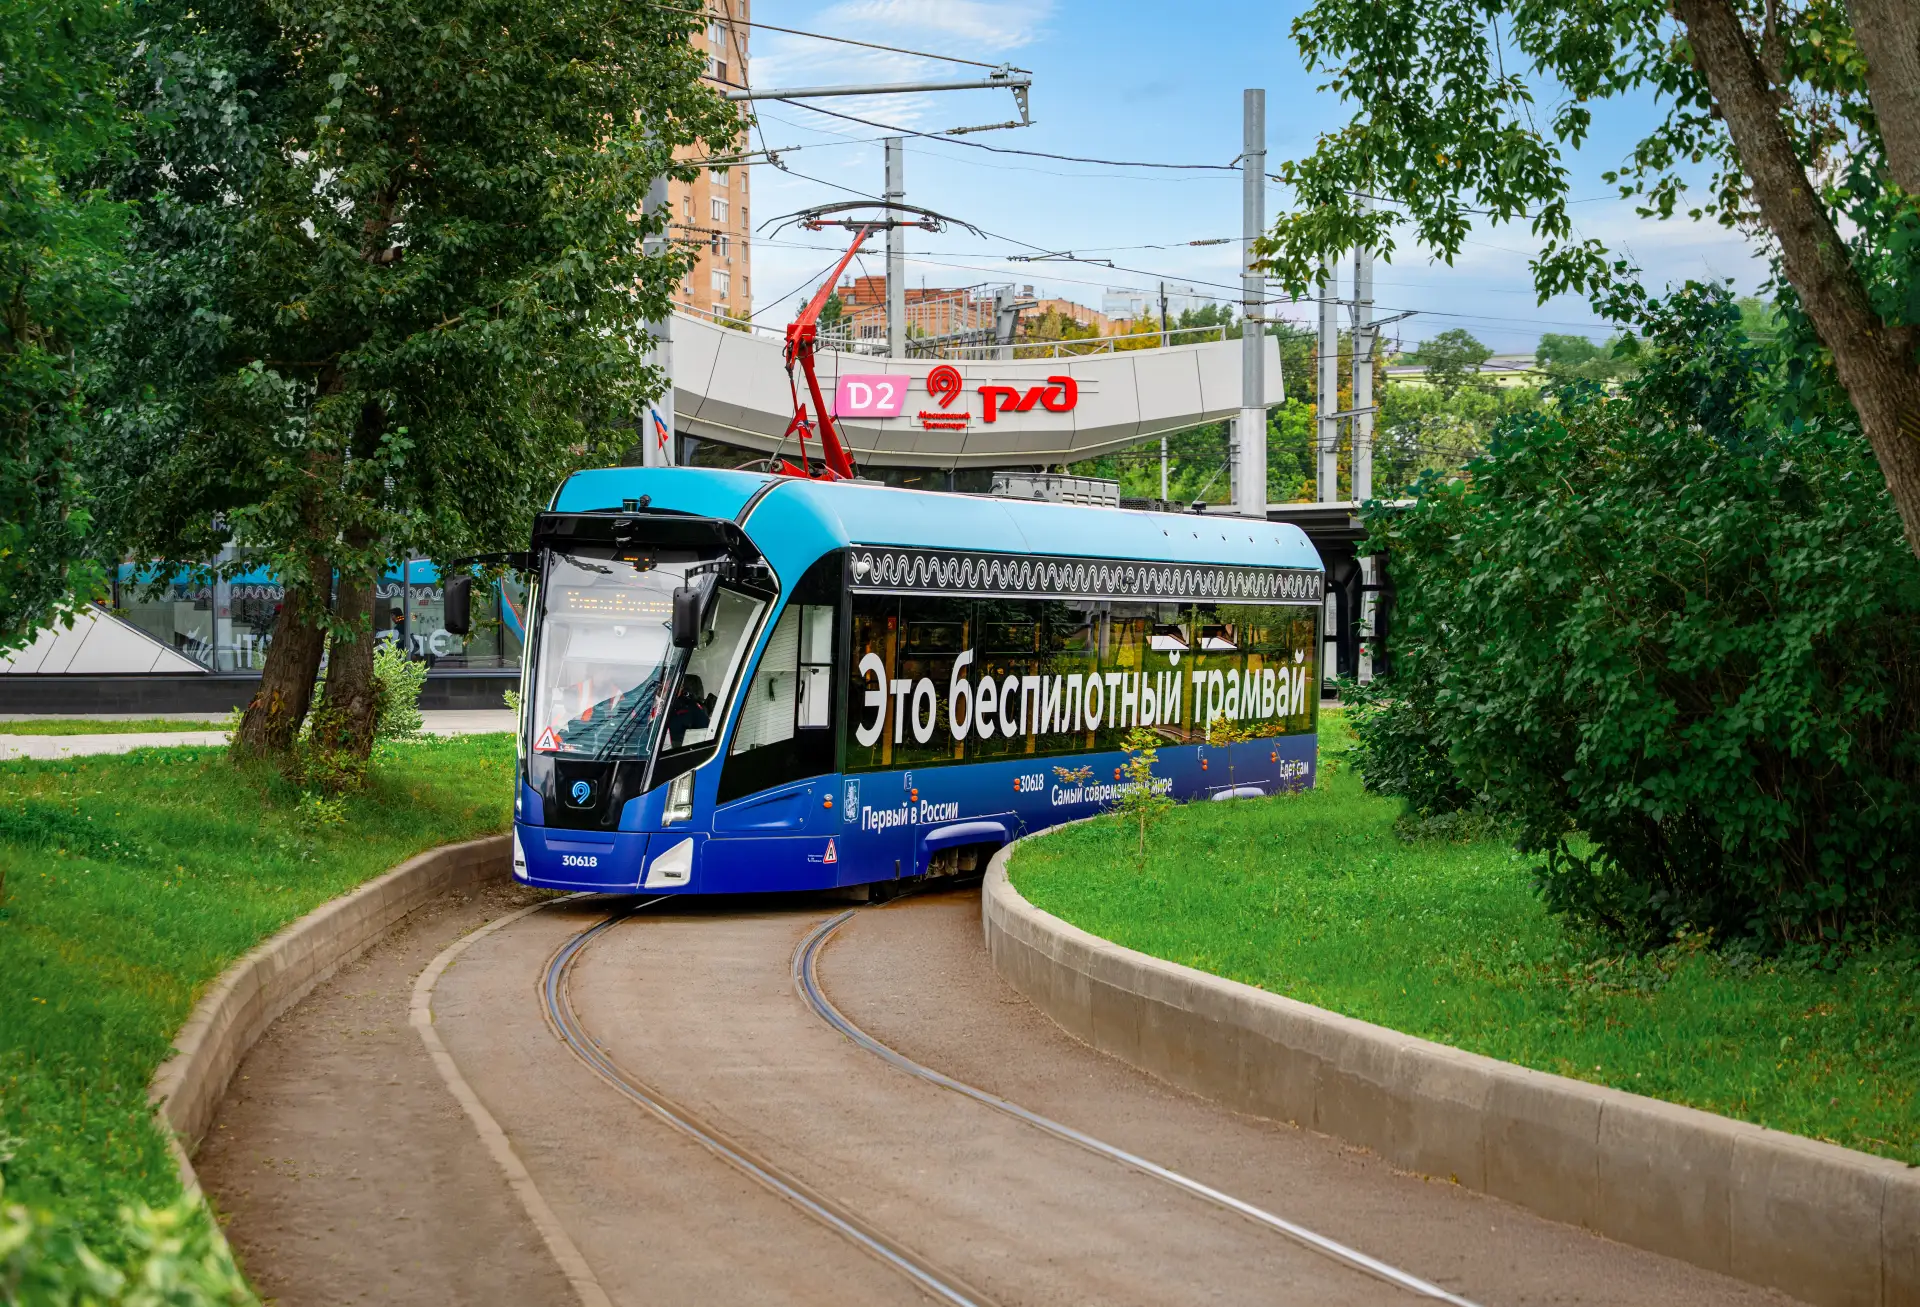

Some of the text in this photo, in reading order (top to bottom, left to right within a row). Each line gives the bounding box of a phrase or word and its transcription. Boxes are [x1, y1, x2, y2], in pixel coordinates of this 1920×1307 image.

[847, 382, 895, 410] D2
[918, 410, 971, 420] Московский
[855, 647, 1306, 747] Это беспилотный трамвай
[1020, 773, 1044, 792] 30618
[1279, 759, 1309, 781] Едет сам
[1051, 780, 1083, 807] Самый
[1084, 778, 1145, 806] современн
[861, 800, 959, 834] Первый в России
[562, 854, 598, 868] 30618
